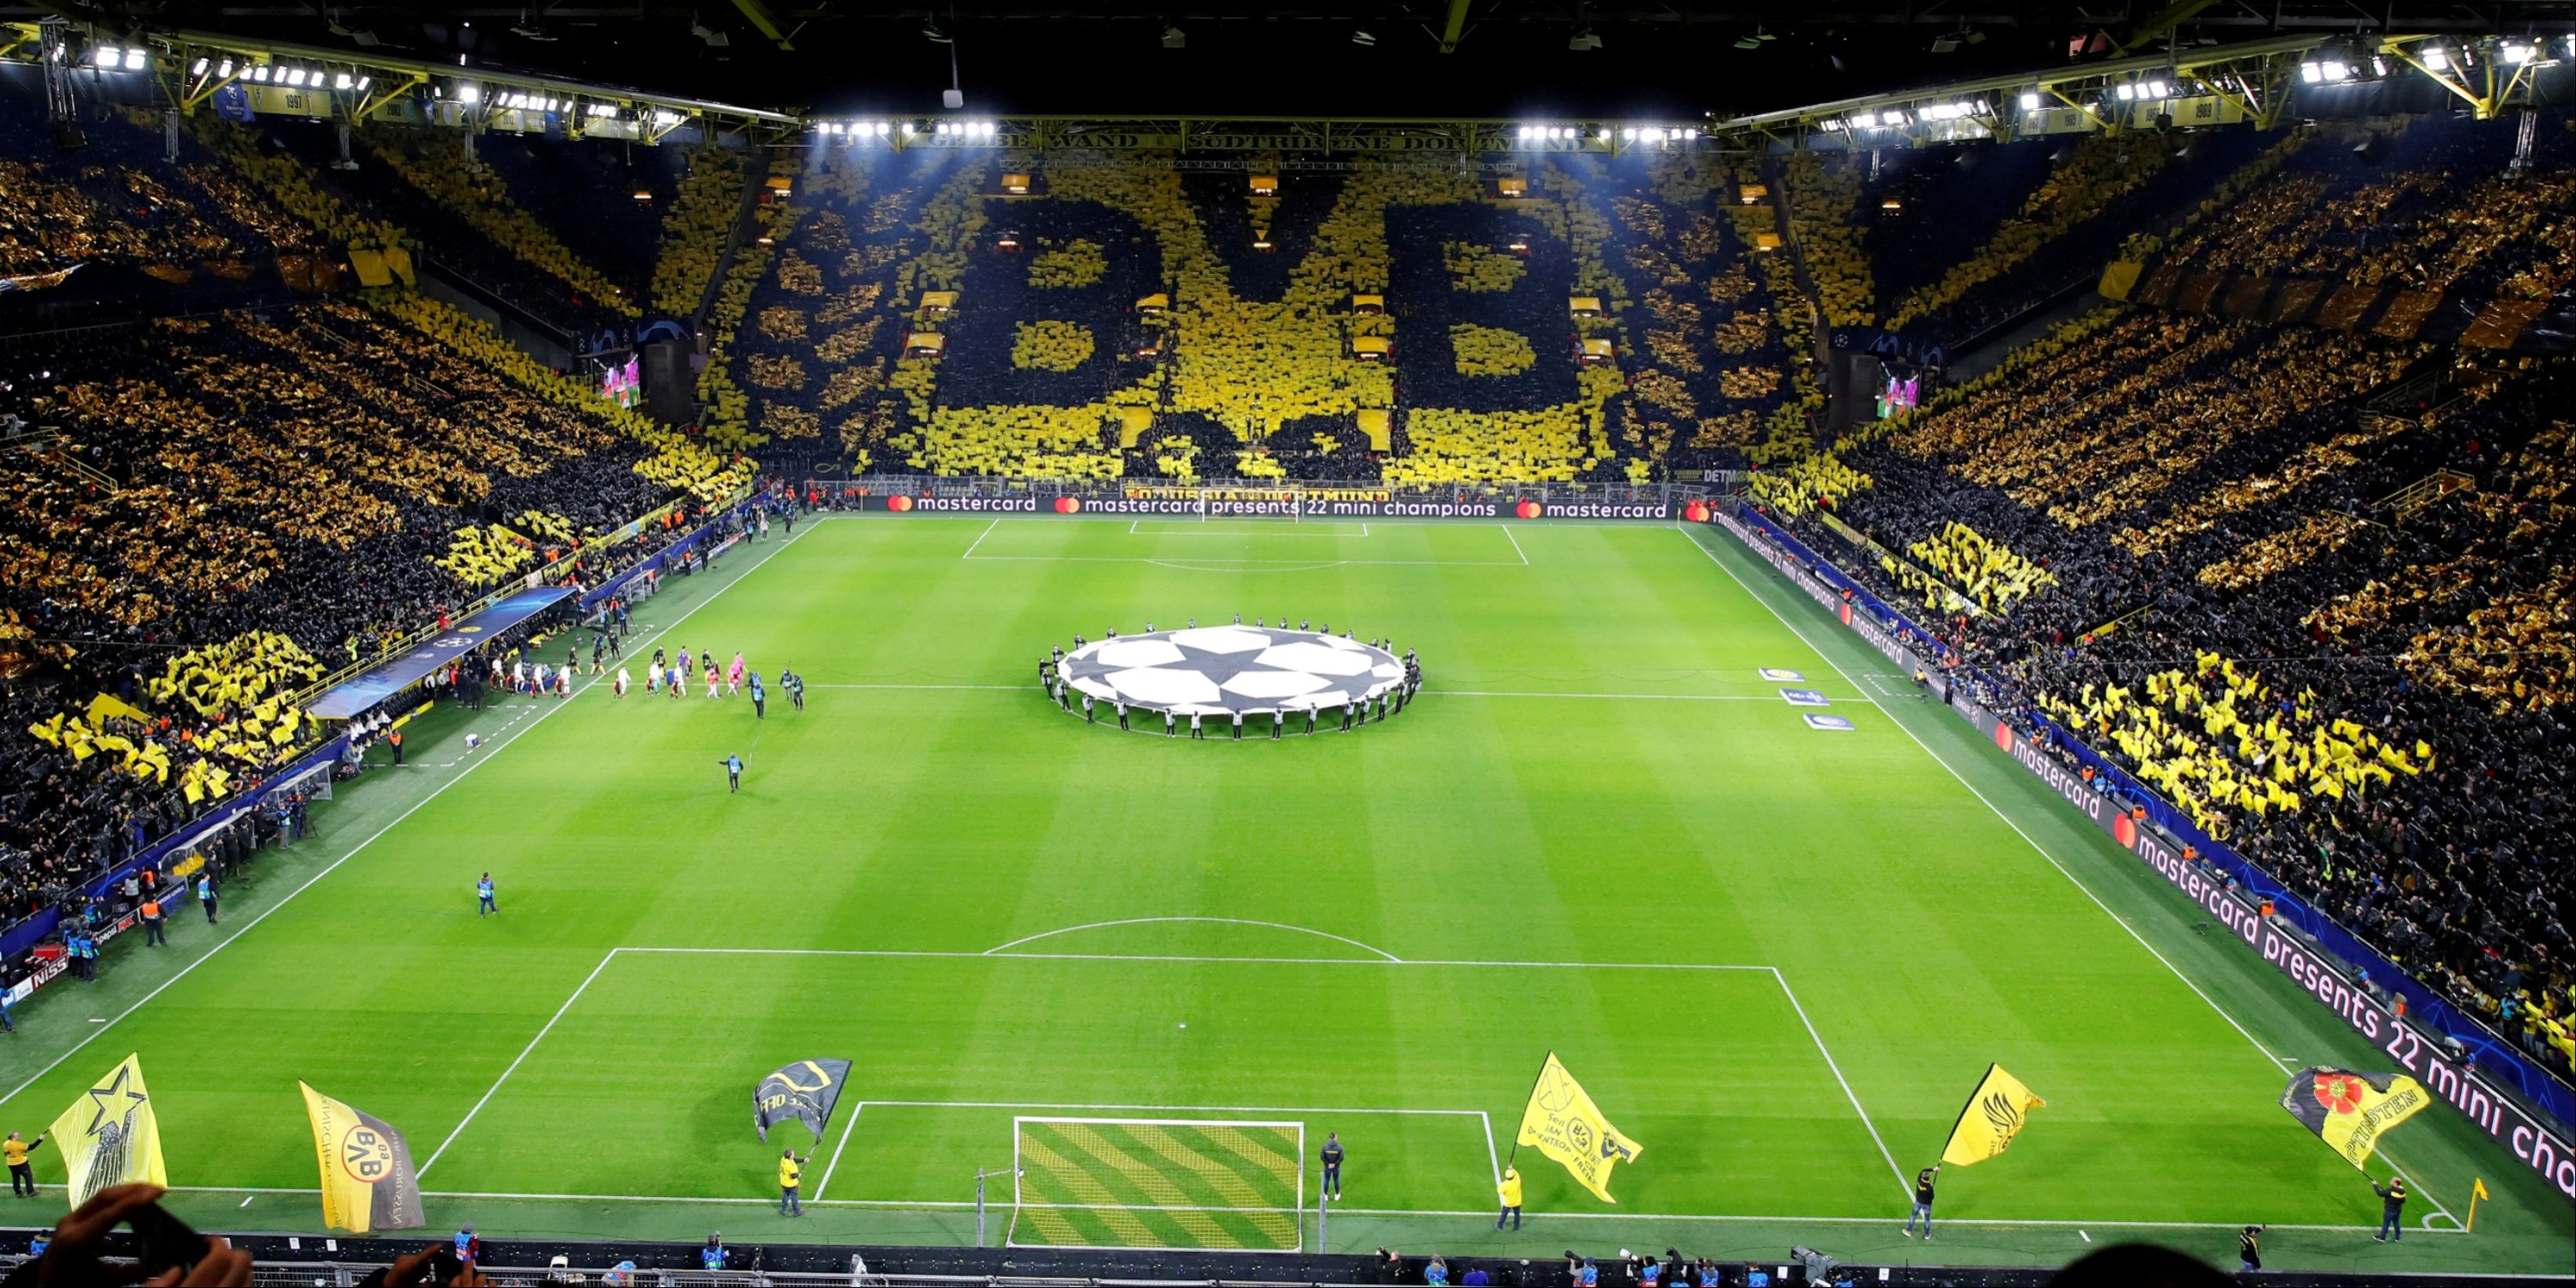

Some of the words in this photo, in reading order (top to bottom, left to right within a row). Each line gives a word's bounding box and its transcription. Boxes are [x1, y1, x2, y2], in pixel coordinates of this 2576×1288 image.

[285, 94, 302, 109] 1997
[2196, 103, 2212, 118] 1989
[1049, 133, 1139, 148] WAND
[1187, 135, 1391, 149] SÜDTRIBÜNE
[1403, 136, 1587, 151] DORTMUND
[918, 496, 1036, 511] mastercard
[1085, 497, 1203, 513] mastercard
[1211, 498, 1300, 516] presents
[1307, 501, 1327, 515] 22
[1334, 501, 1377, 516] mini
[1383, 501, 1496, 518] champions
[1546, 502, 1667, 519] mastercard
[1713, 511, 1749, 547] mastercard
[1748, 534, 1775, 563] presents
[1773, 552, 1782, 567] 22
[1782, 556, 1796, 582] mini
[1795, 569, 1835, 612] champions
[1851, 613, 1904, 664] mastercard
[2014, 738, 2101, 820] mastercard
[98, 925, 117, 945] pepsi
[33, 956, 68, 988] NISS
[2138, 835, 2259, 945] mastercard
[2263, 928, 2379, 1039] presents
[2385, 1020, 2419, 1071] 22
[2427, 1056, 2503, 1136] mini
